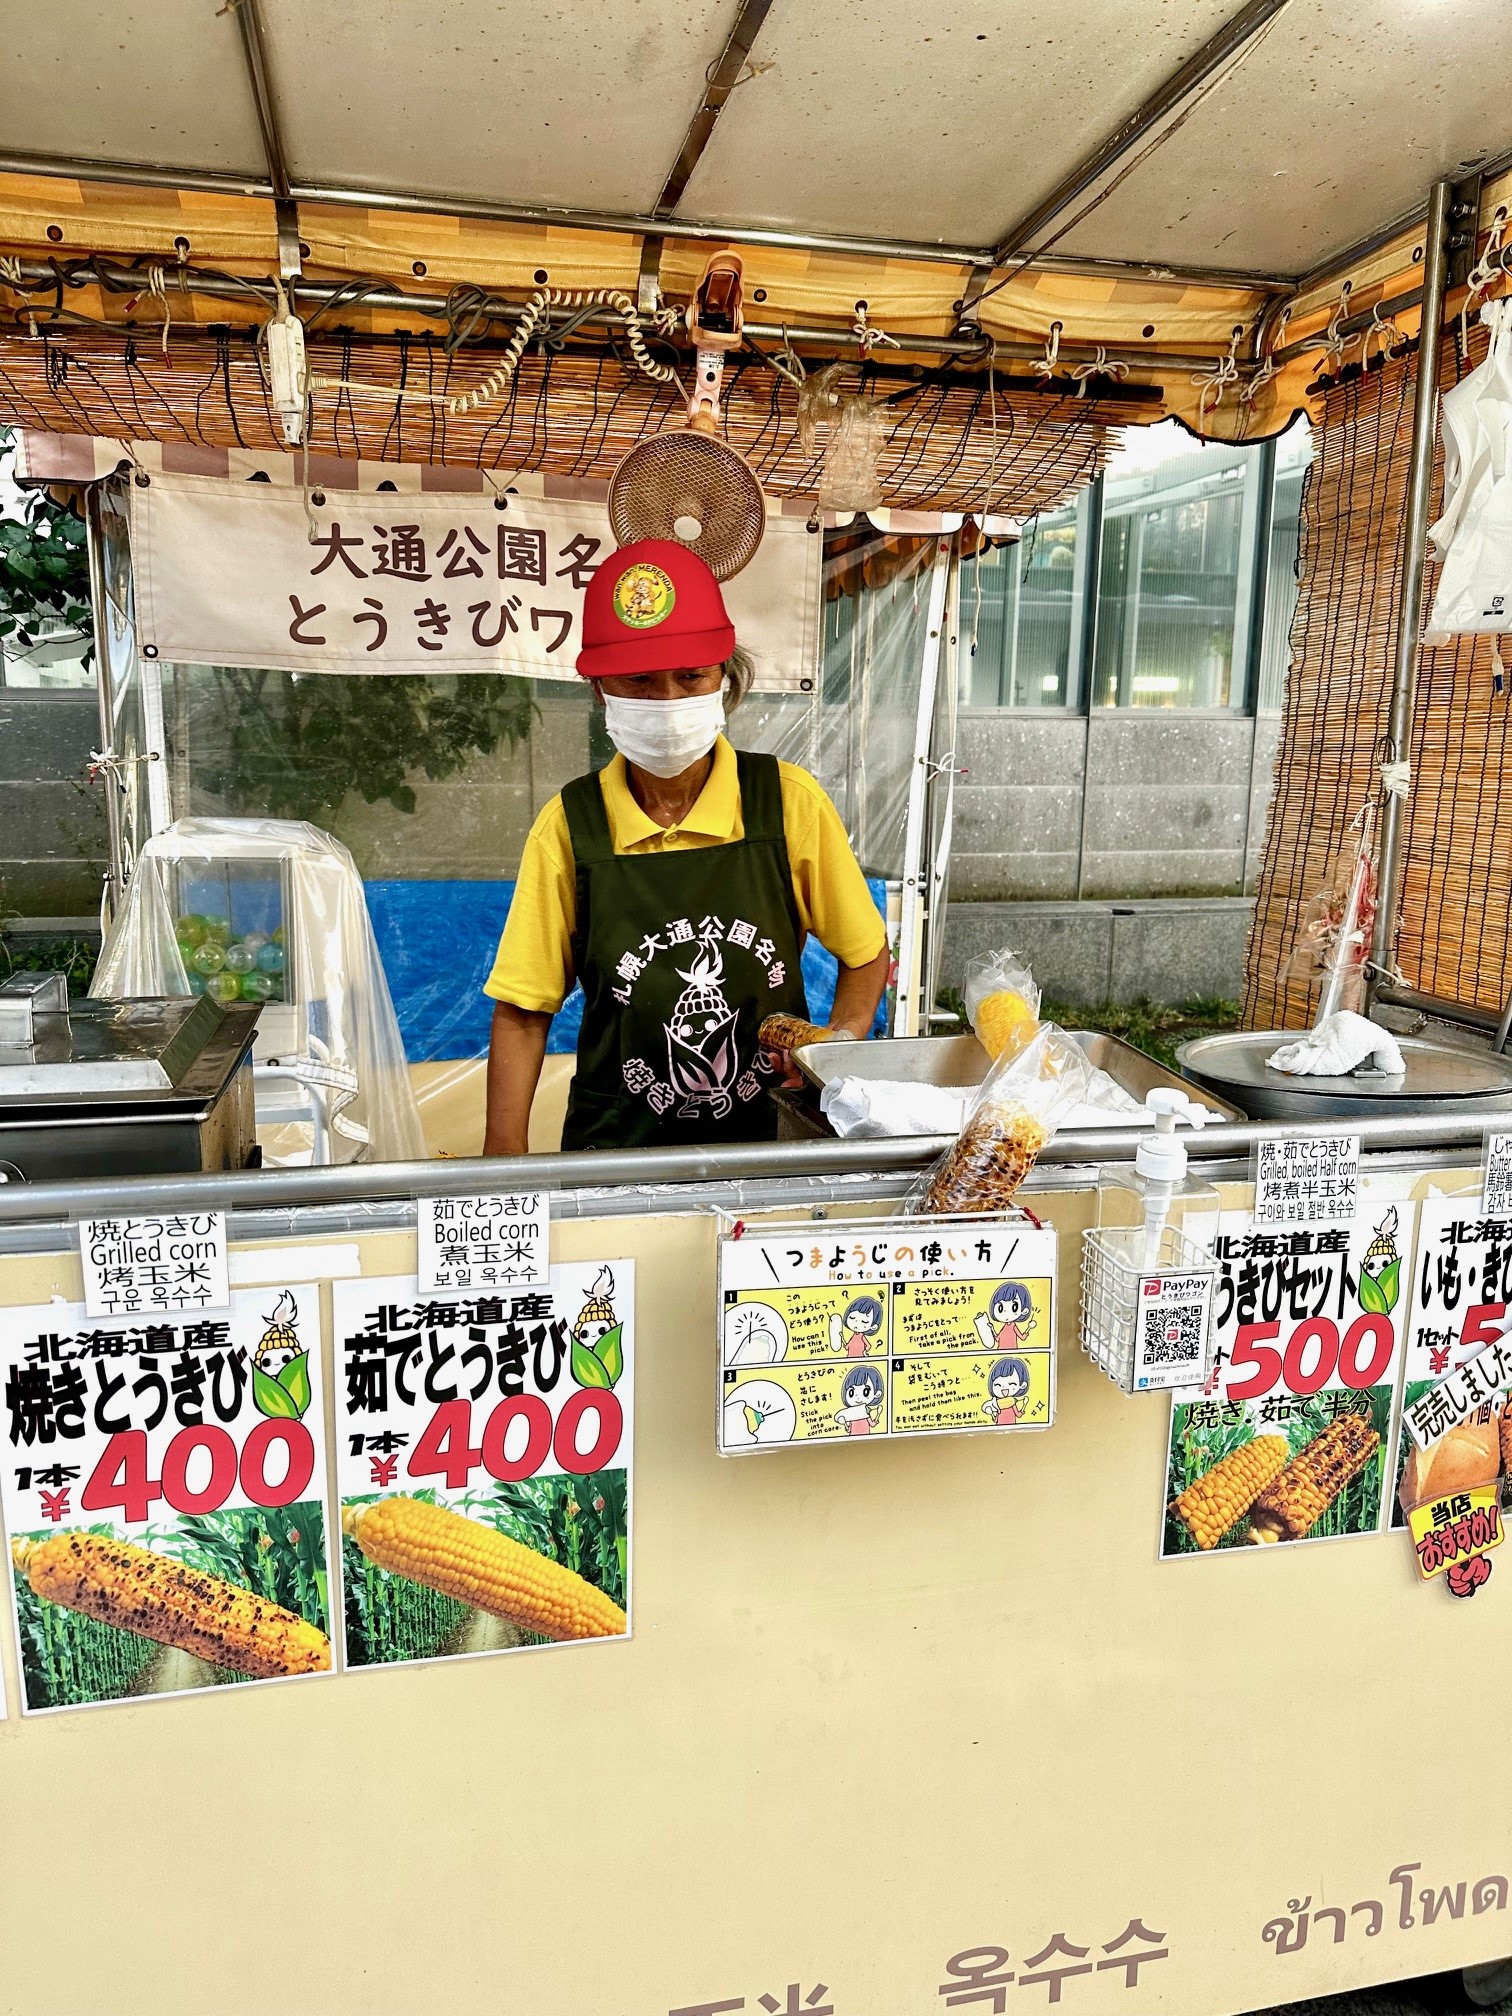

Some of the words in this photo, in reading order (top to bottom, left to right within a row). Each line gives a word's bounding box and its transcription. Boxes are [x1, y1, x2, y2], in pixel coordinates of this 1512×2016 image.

[309, 522, 603, 590] 大通公園名
[288, 593, 574, 653] とうきびワ
[611, 915, 787, 1006] 札幌大通公園名物
[1291, 1159, 1318, 1178] boiled
[1319, 1157, 1338, 1177] Half
[1338, 1161, 1357, 1176] corn
[1262, 1177, 1356, 1201] 烤煮半玉米
[432, 1193, 541, 1222] 茹でとうきび
[1258, 1202, 1286, 1222] 구이와
[1287, 1201, 1305, 1221] 보일
[1307, 1200, 1326, 1220] 절반
[1327, 1199, 1354, 1219] 옥수수
[87, 1212, 219, 1244] 焼とうきび
[434, 1220, 493, 1244] Boiled
[499, 1221, 540, 1240] corn
[1439, 1217, 1512, 1246] 北海
[90, 1239, 162, 1267] Grilled
[169, 1239, 217, 1261] corn
[439, 1240, 535, 1267] 煮玉米
[786, 1239, 993, 1268] つまようじの使い方
[1215, 1228, 1351, 1261] 北海道産
[97, 1262, 212, 1289] 烤玉米
[433, 1268, 473, 1288] 보일
[479, 1264, 540, 1286] 옥수수
[828, 1270, 852, 1281] How
[857, 1269, 873, 1280] to
[879, 1268, 902, 1279] use
[908, 1269, 915, 1278] a
[922, 1266, 954, 1279] pick.
[1163, 1279, 1208, 1292] PayPay
[100, 1288, 143, 1315] 구운
[150, 1283, 213, 1312] 옥수수
[729, 1293, 733, 1302] 1
[786, 1294, 801, 1302] この
[896, 1284, 902, 1293] 2
[364, 1293, 556, 1333] 北海道産
[24, 1321, 234, 1364] 北海道産
[918, 1340, 935, 1348] take
[942, 1335, 957, 1345] pick
[929, 1331, 938, 1339] of
[946, 1342, 959, 1350] the
[810, 1344, 829, 1355] pick?
[344, 1317, 568, 1416] 茹でとうきび
[727, 1372, 733, 1382] 3
[797, 1367, 835, 1382] とうきびの
[895, 1361, 901, 1370] 4
[5, 1345, 249, 1448] 焼きとうきび
[901, 1398, 917, 1406] Then
[917, 1394, 931, 1403] peel
[908, 1404, 921, 1412] and
[921, 1402, 936, 1410] hold
[800, 1409, 819, 1418] Stick
[805, 1415, 817, 1424] the
[818, 1413, 833, 1423] pick
[810, 1422, 824, 1431] into
[348, 1430, 410, 1457] 1本
[14, 1463, 81, 1491] 1本
[1430, 1492, 1472, 1528] 当店
[1415, 1504, 1499, 1573] おすすめ!
[938, 1918, 1169, 2016] 옥수수
